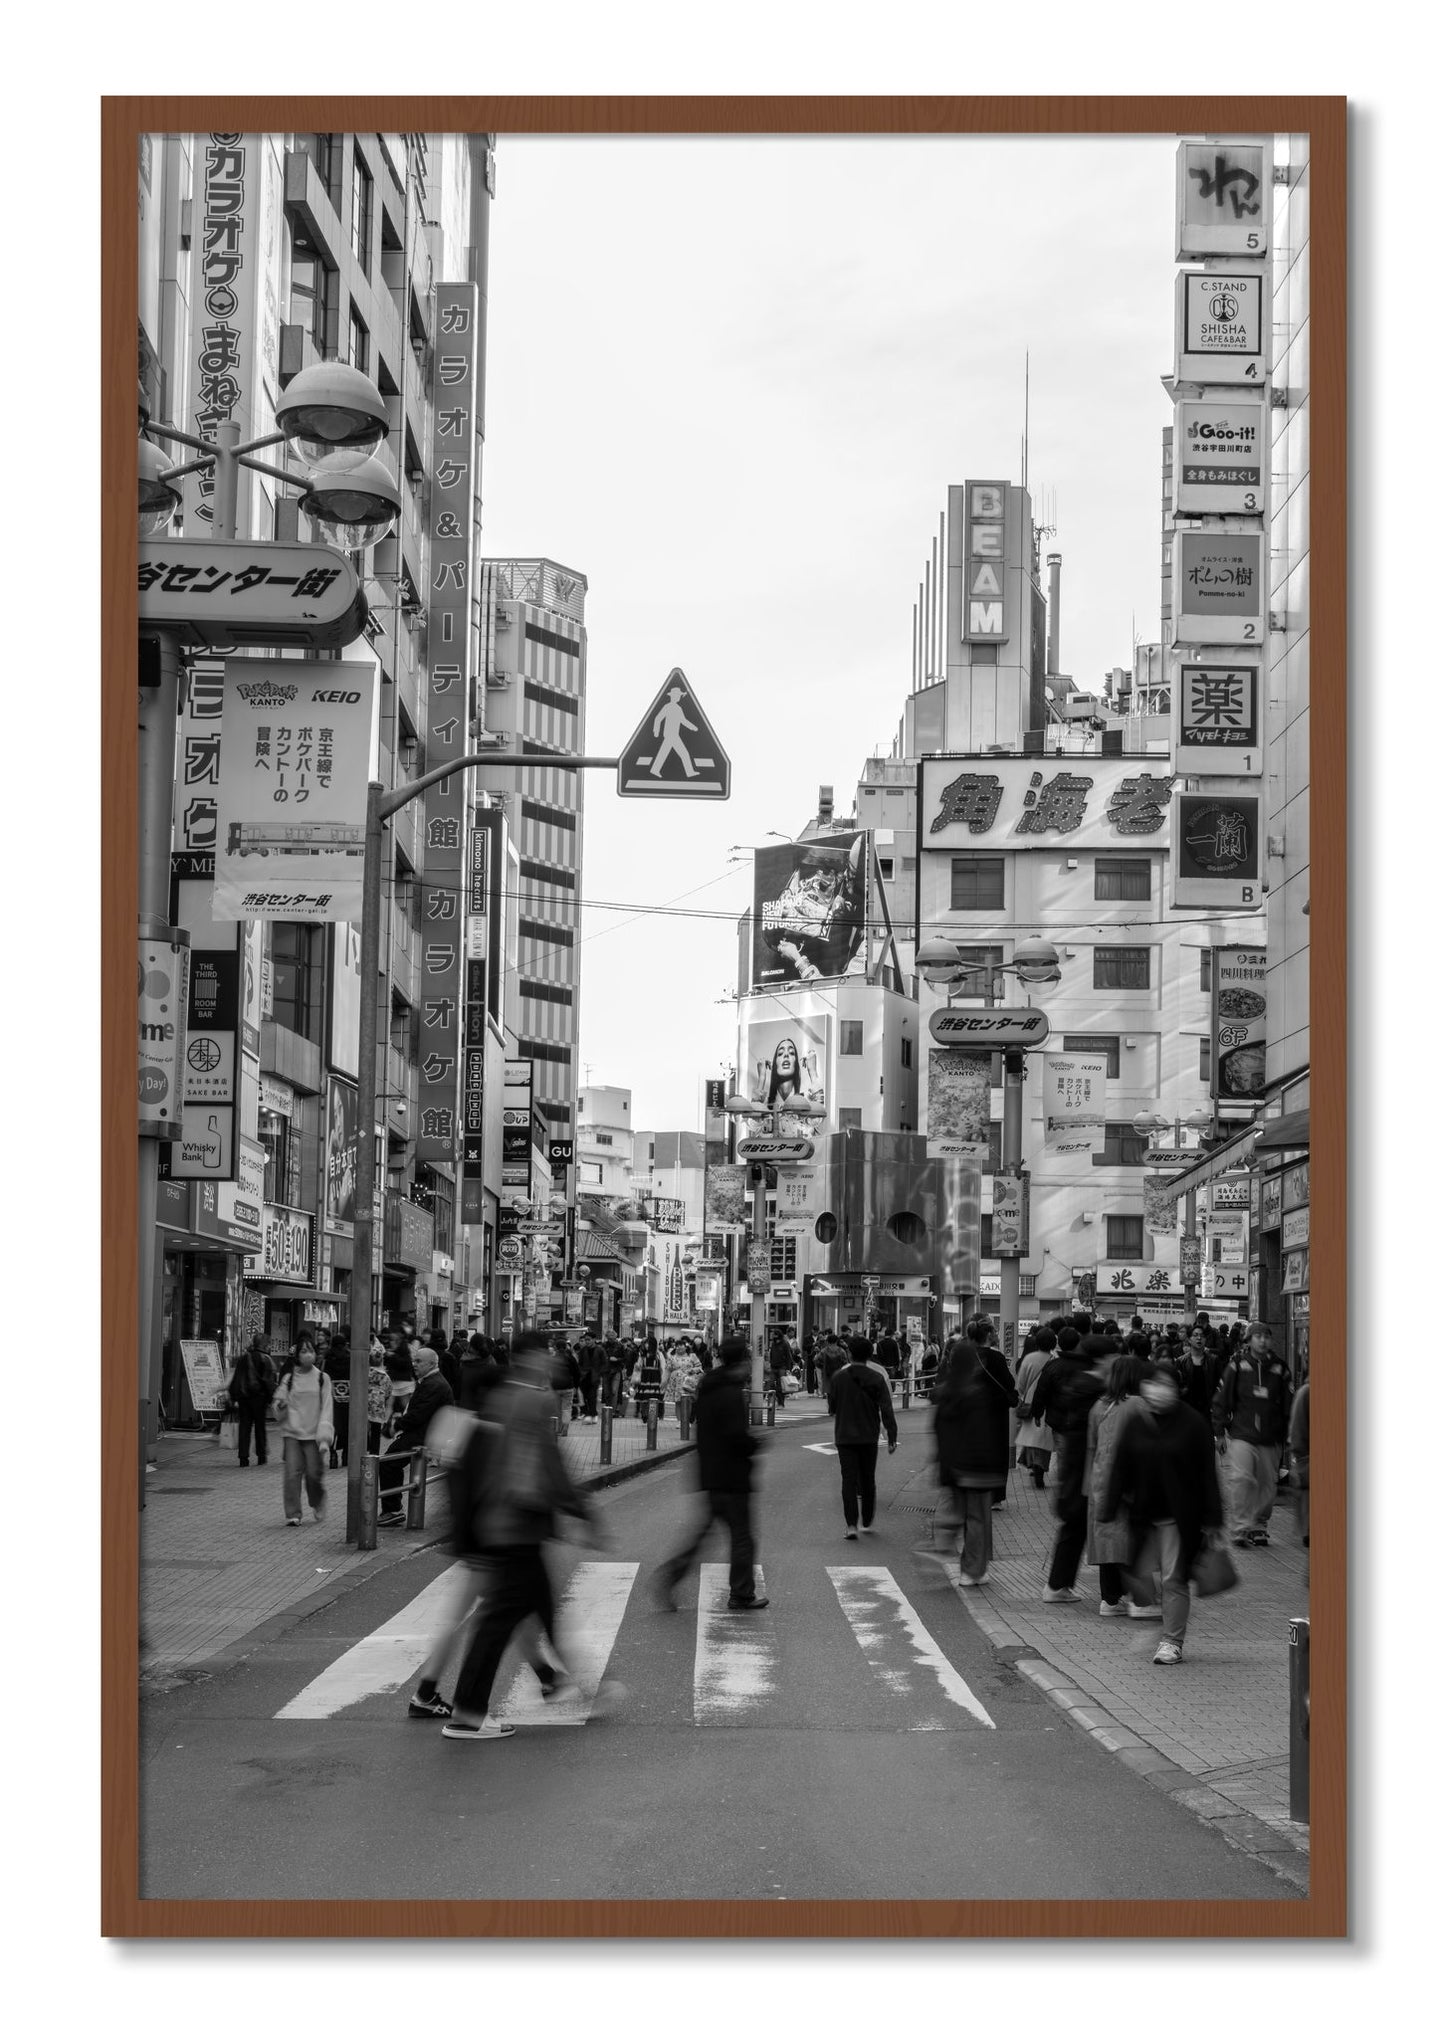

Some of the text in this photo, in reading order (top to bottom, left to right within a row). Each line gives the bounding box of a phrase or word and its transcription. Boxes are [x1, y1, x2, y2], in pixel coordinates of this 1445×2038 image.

[203, 146, 246, 288] カラオケ
[1246, 233, 1259, 249] 5
[1200, 281, 1247, 292] C.STAND
[1200, 323, 1247, 334] SHISHA
[1200, 334, 1247, 344] CAFE&BAR
[1245, 363, 1258, 378] 4
[1199, 423, 1256, 440] Goo-it!
[1191, 443, 1253, 454] 渋谷宇田川町店
[1186, 468, 1257, 482] 全身もみほぐし
[1244, 492, 1257, 510] 3
[969, 486, 1004, 634] BEAM
[1198, 590, 1245, 598] Pomme-no-ki
[1243, 623, 1256, 640] 2
[249, 698, 286, 707] KANTO
[311, 689, 362, 705] KEIO
[1191, 673, 1244, 726] 薬
[1185, 728, 1250, 744] マツモトキヨシ
[254, 726, 272, 771] 冒険へ
[273, 726, 292, 803] カントーの
[316, 726, 335, 789] 京王線で
[1243, 755, 1252, 771] 1
[294, 726, 314, 804] ポケパーク
[929, 771, 1176, 834] 角海老
[1185, 811, 1248, 863] 一蘭
[473, 832, 484, 910] kimono hearts
[241, 893, 334, 907] 渋谷センター街
[1242, 886, 1254, 903] B
[195, 970, 218, 978] THIRD
[199, 963, 214, 971] THE
[194, 1000, 217, 1008] ROOM
[198, 1010, 213, 1019] BAR
[936, 1017, 1042, 1031] 渋谷センター街
[1218, 1026, 1248, 1047] 6F
[1080, 1064, 1103, 1072] KEIO
[146, 1077, 167, 1091] Day!
[212, 1089, 229, 1097] BAR
[182, 1143, 217, 1154] Whisky
[551, 1146, 572, 1157] GU
[741, 1143, 804, 1153] 渋谷センター街
[939, 1145, 977, 1153] 渋谷センター街
[1056, 1142, 1092, 1152] 渋谷センター街
[181, 1153, 203, 1161] Bank
[1110, 1268, 1172, 1291] 兆楽
[671, 1266, 682, 1310] BEER
[502, 1292, 510, 1301] G
